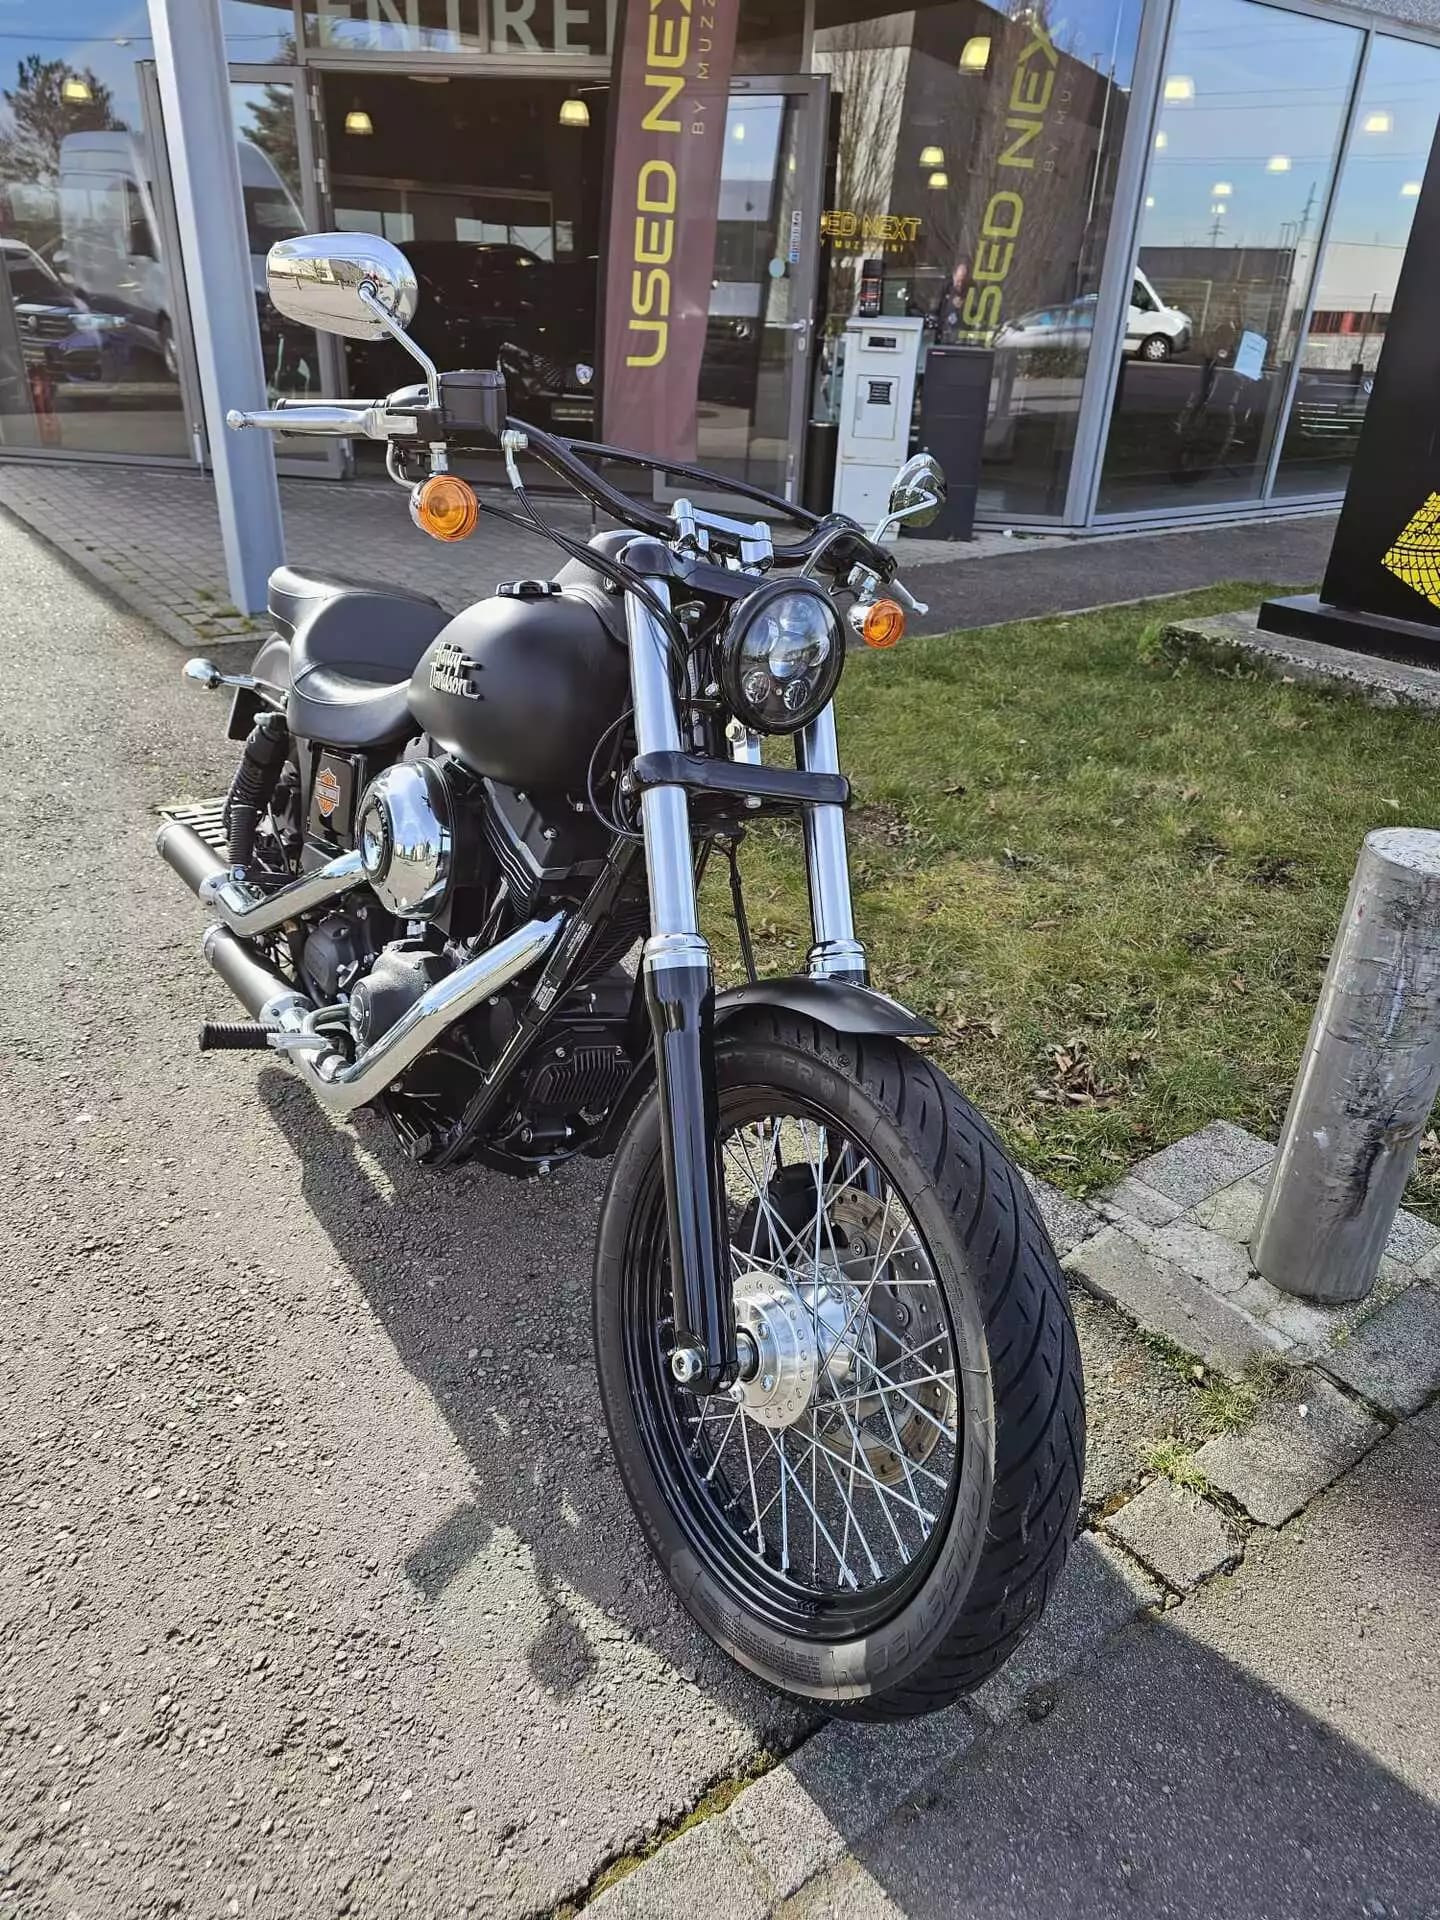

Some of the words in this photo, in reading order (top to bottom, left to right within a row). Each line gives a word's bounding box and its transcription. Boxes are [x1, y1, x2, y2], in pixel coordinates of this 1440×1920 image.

[691, 100, 706, 135] BY
[862, 214, 922, 241] NEXT
[627, 159, 677, 368] USED
